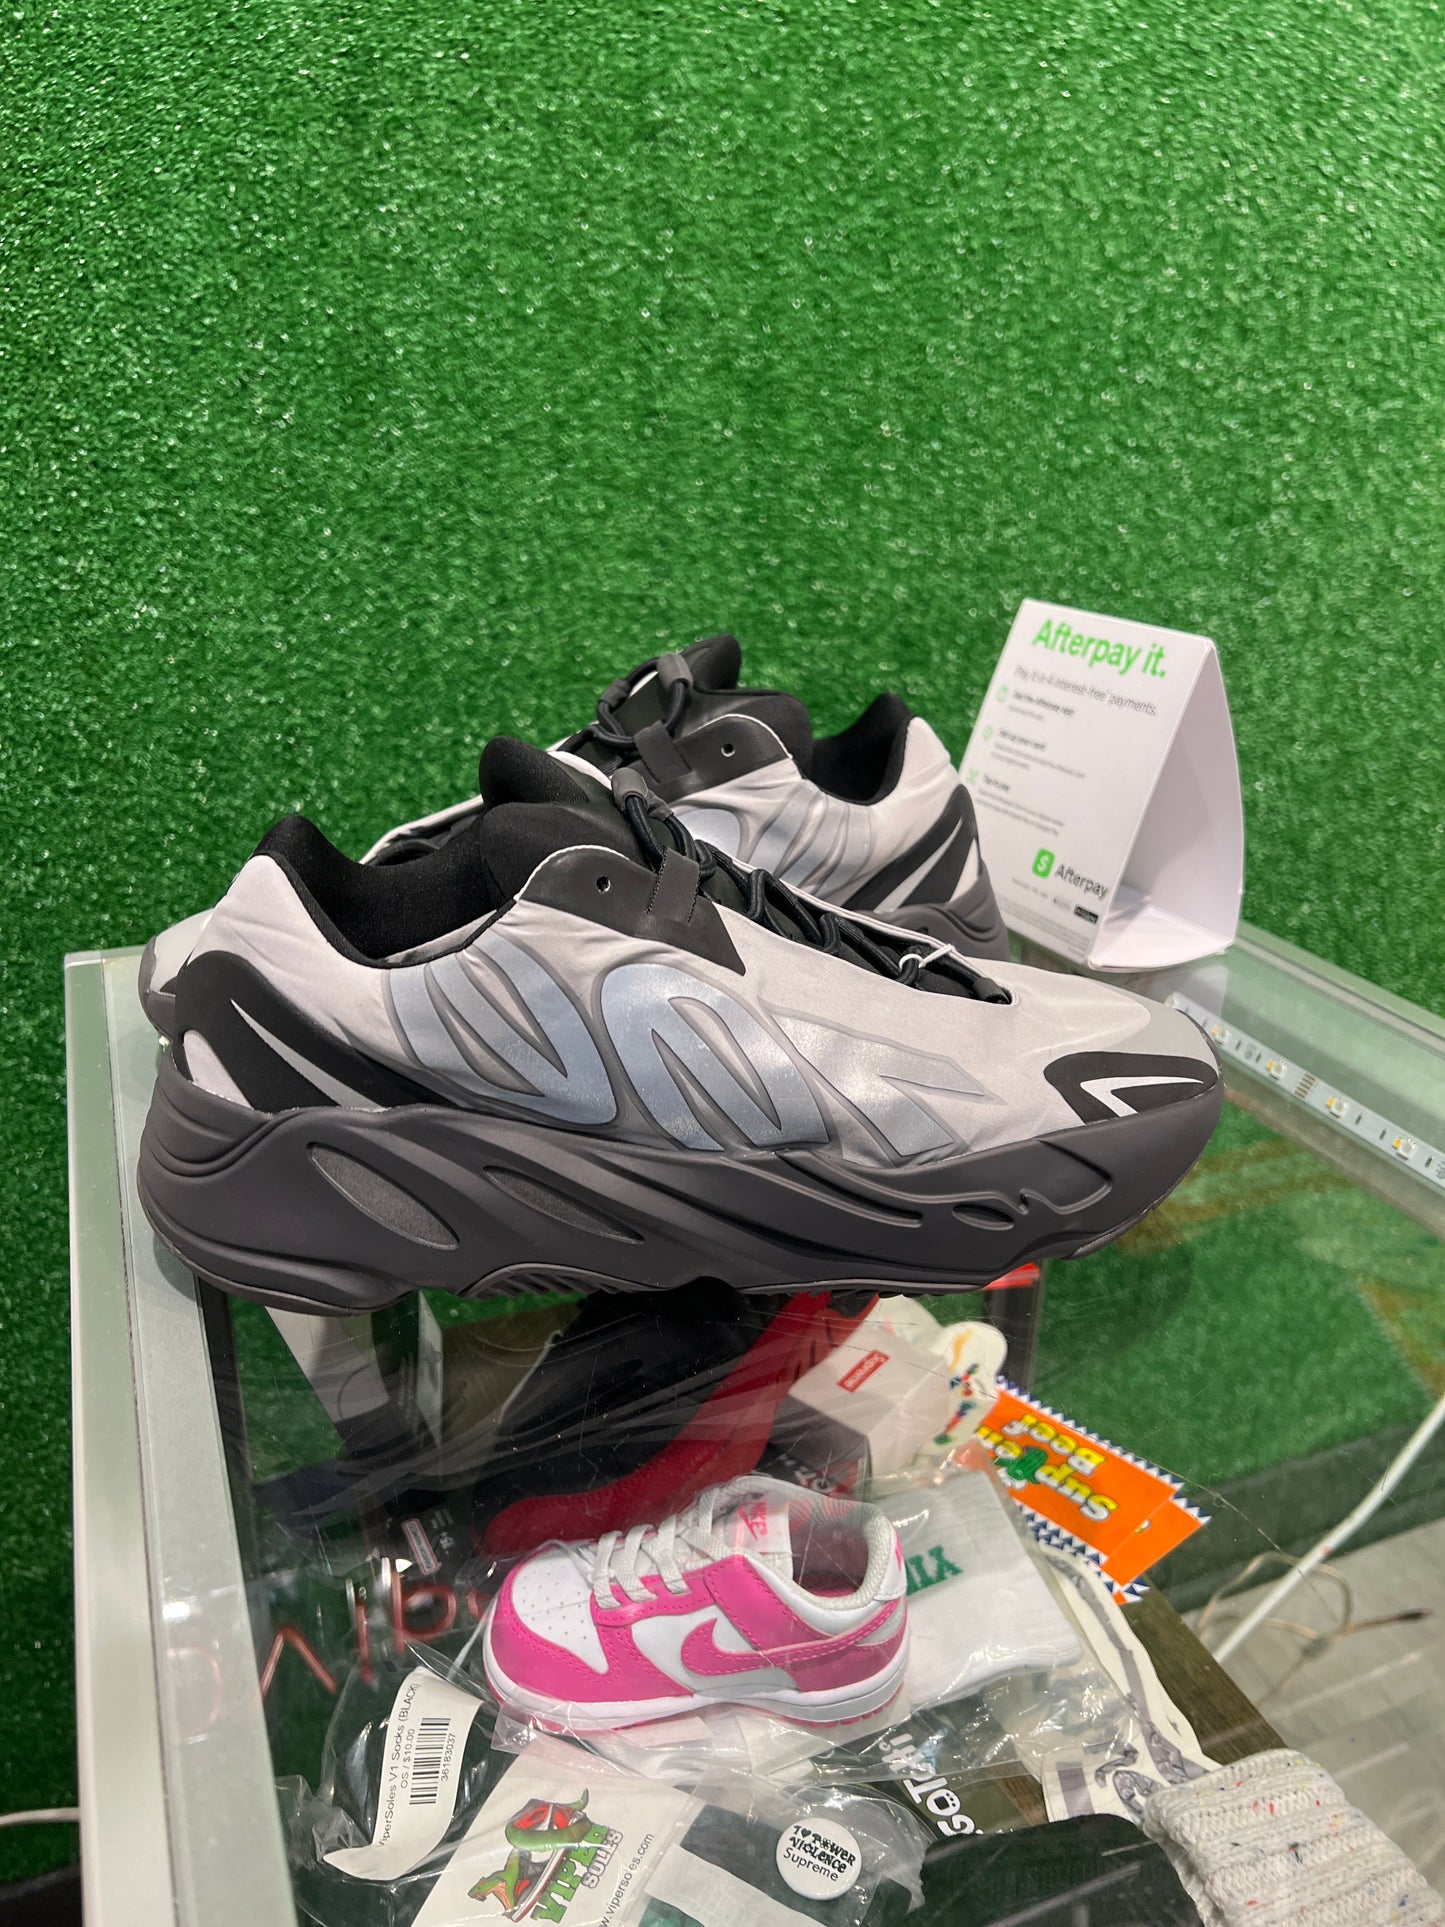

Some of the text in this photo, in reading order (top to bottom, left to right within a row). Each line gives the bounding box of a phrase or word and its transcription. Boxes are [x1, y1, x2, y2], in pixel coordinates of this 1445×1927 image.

[1033, 619, 1167, 678] Afterpay it.
[1054, 863, 1109, 899] Afterpay
[1002, 1413, 1107, 1477] Beef
[392, 1726, 405, 1762] Socks
[402, 1728, 415, 1764] $10.00
[440, 1733, 456, 1782] 36183037
[389, 1766, 398, 1783] V1
[400, 1772, 409, 1789] OS
[530, 1824, 609, 1923] VIPER
[581, 1828, 623, 1889] SOLES
[784, 1847, 838, 1881] Supreme
